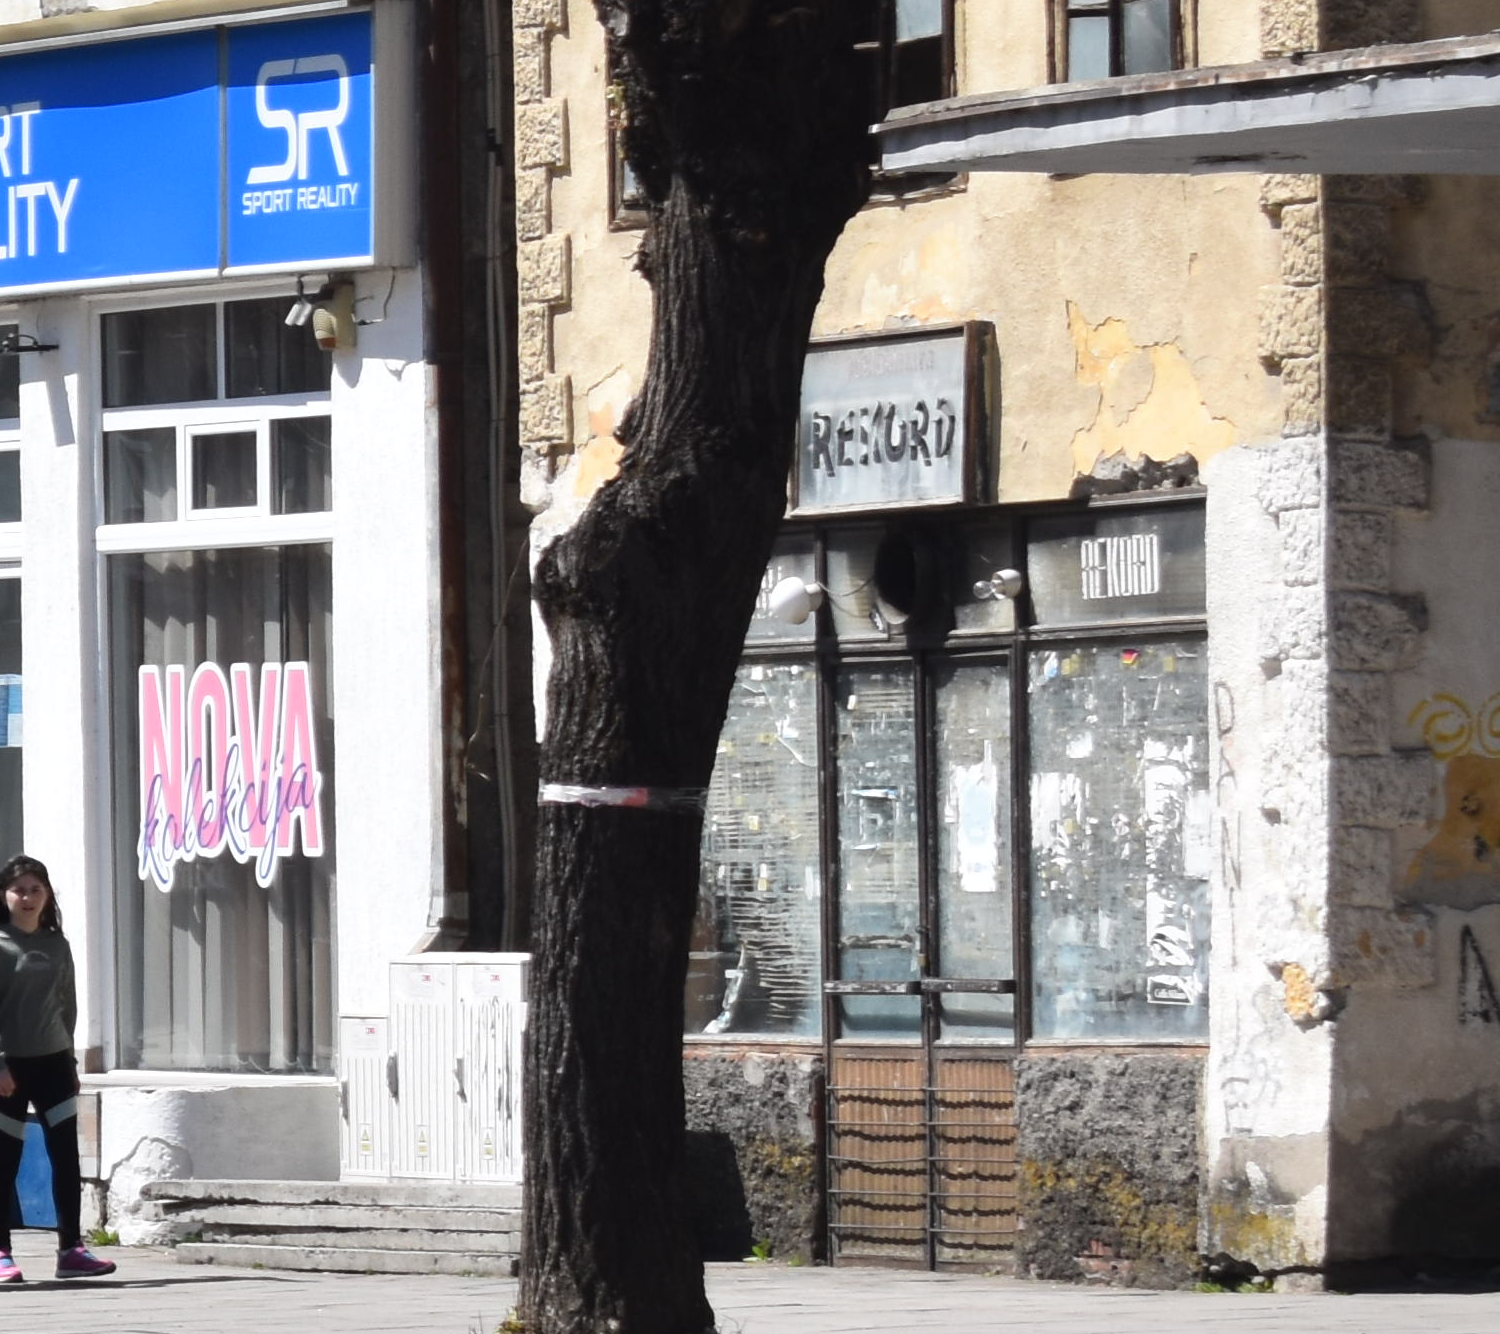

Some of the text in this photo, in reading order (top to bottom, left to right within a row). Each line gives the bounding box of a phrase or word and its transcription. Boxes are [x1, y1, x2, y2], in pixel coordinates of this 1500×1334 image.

[242, 183, 359, 216] SPORT REALITY
[1081, 534, 1159, 601] REKORD
[138, 661, 324, 858] NOVA
[141, 742, 320, 885] kolekcija
